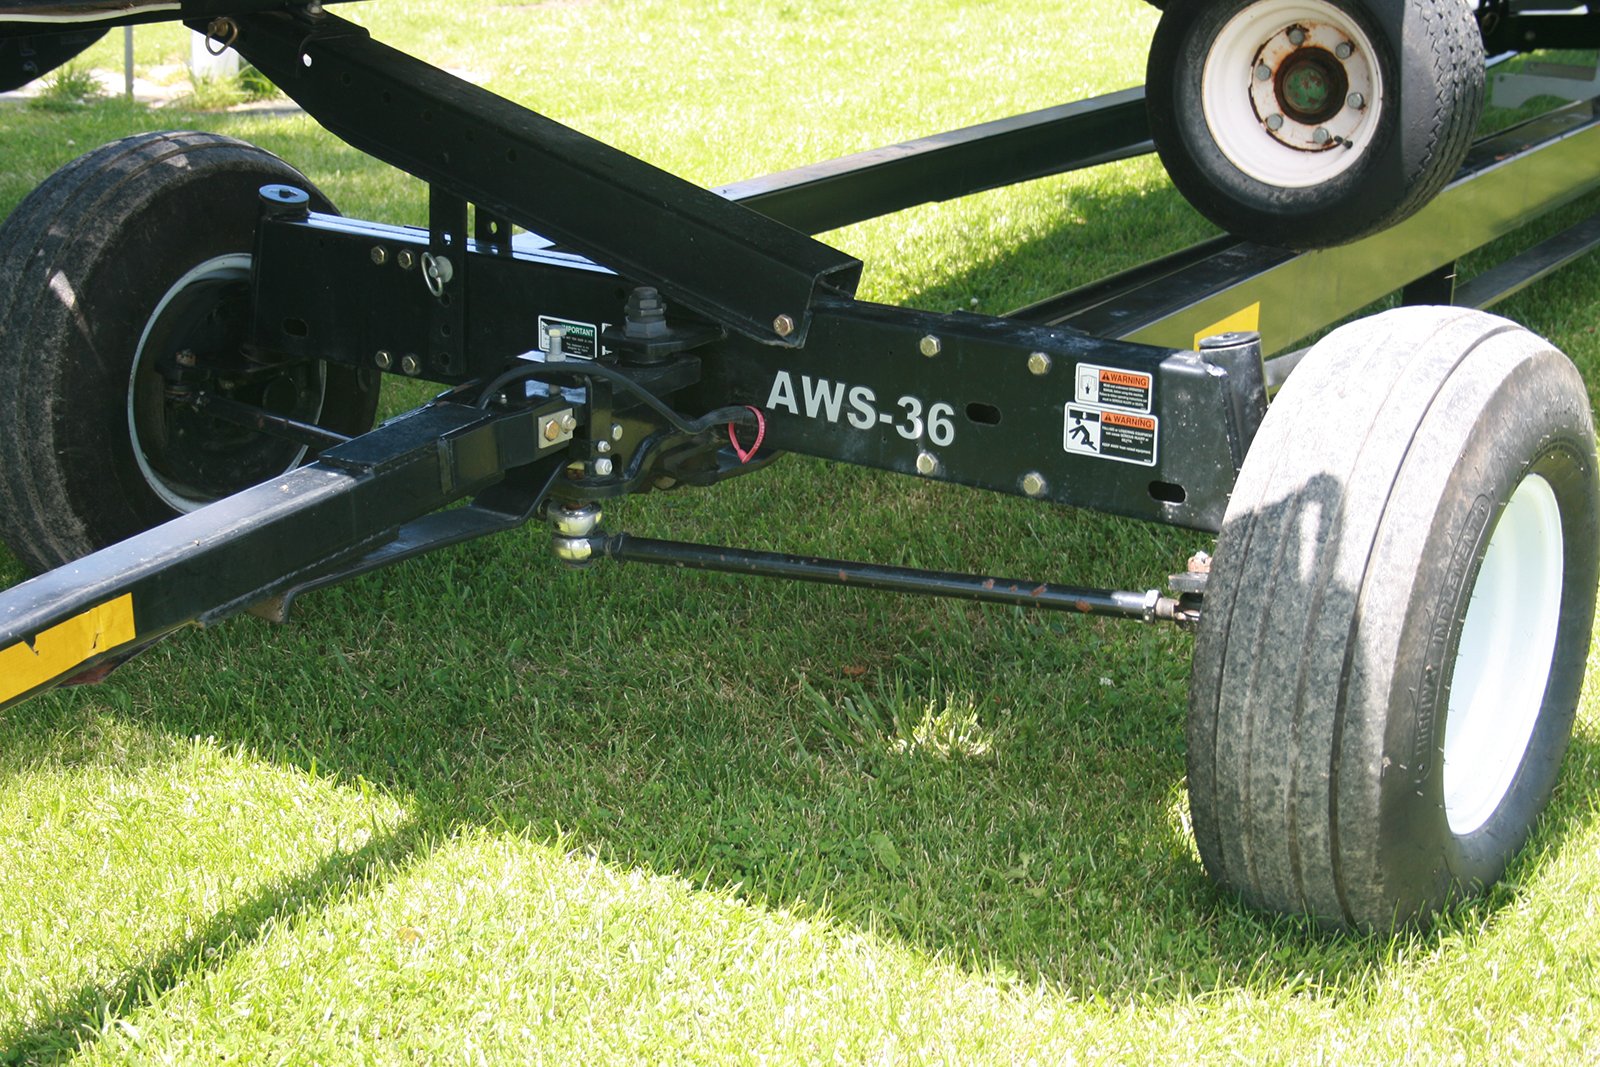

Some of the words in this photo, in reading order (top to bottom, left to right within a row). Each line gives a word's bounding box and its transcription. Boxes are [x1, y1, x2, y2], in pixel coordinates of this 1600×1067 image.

[1109, 375, 1147, 386] WARNING
[766, 370, 955, 447] AWS-36
[1113, 417, 1152, 428] WARNING
